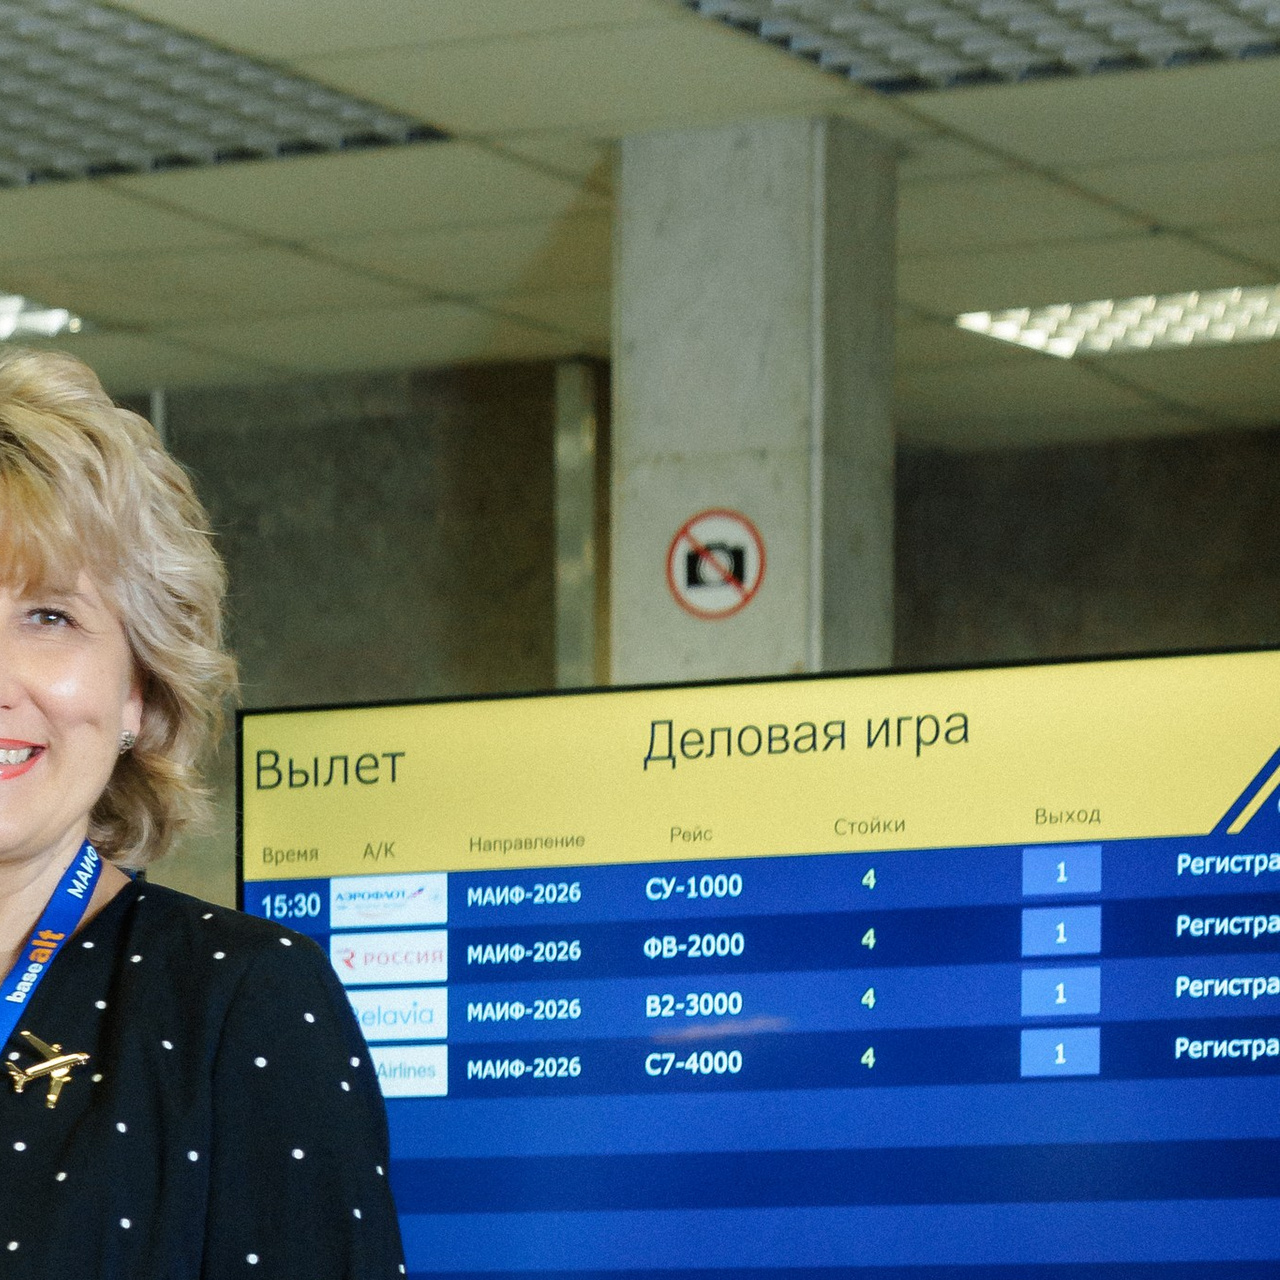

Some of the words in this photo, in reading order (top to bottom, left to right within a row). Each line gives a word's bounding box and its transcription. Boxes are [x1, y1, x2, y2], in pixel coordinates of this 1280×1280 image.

[644, 719, 846, 770] Деловая
[867, 712, 970, 757] игра
[256, 749, 406, 791] Вылет
[262, 846, 319, 866] Время
[469, 834, 585, 855] Направление
[670, 825, 713, 843] Рейс
[834, 816, 906, 836] Стойки
[1035, 806, 1101, 826] Выход
[67, 845, 99, 899] МАИФ
[467, 883, 581, 906] МАИФ-2026
[861, 868, 876, 890] 4
[1055, 861, 1068, 883] 1
[261, 892, 320, 918] 15:30
[363, 950, 443, 966] РОССИЯ
[467, 941, 581, 964] МАИФ-2026
[861, 928, 876, 950] 4
[1055, 921, 1068, 943] 1
[467, 999, 581, 1022] МАИФ-2026
[861, 988, 876, 1009] 4
[1055, 983, 1068, 1004] 1
[467, 1057, 581, 1080] МАИФ-2026
[861, 1047, 876, 1069] 4
[1055, 1043, 1068, 1065] 1
